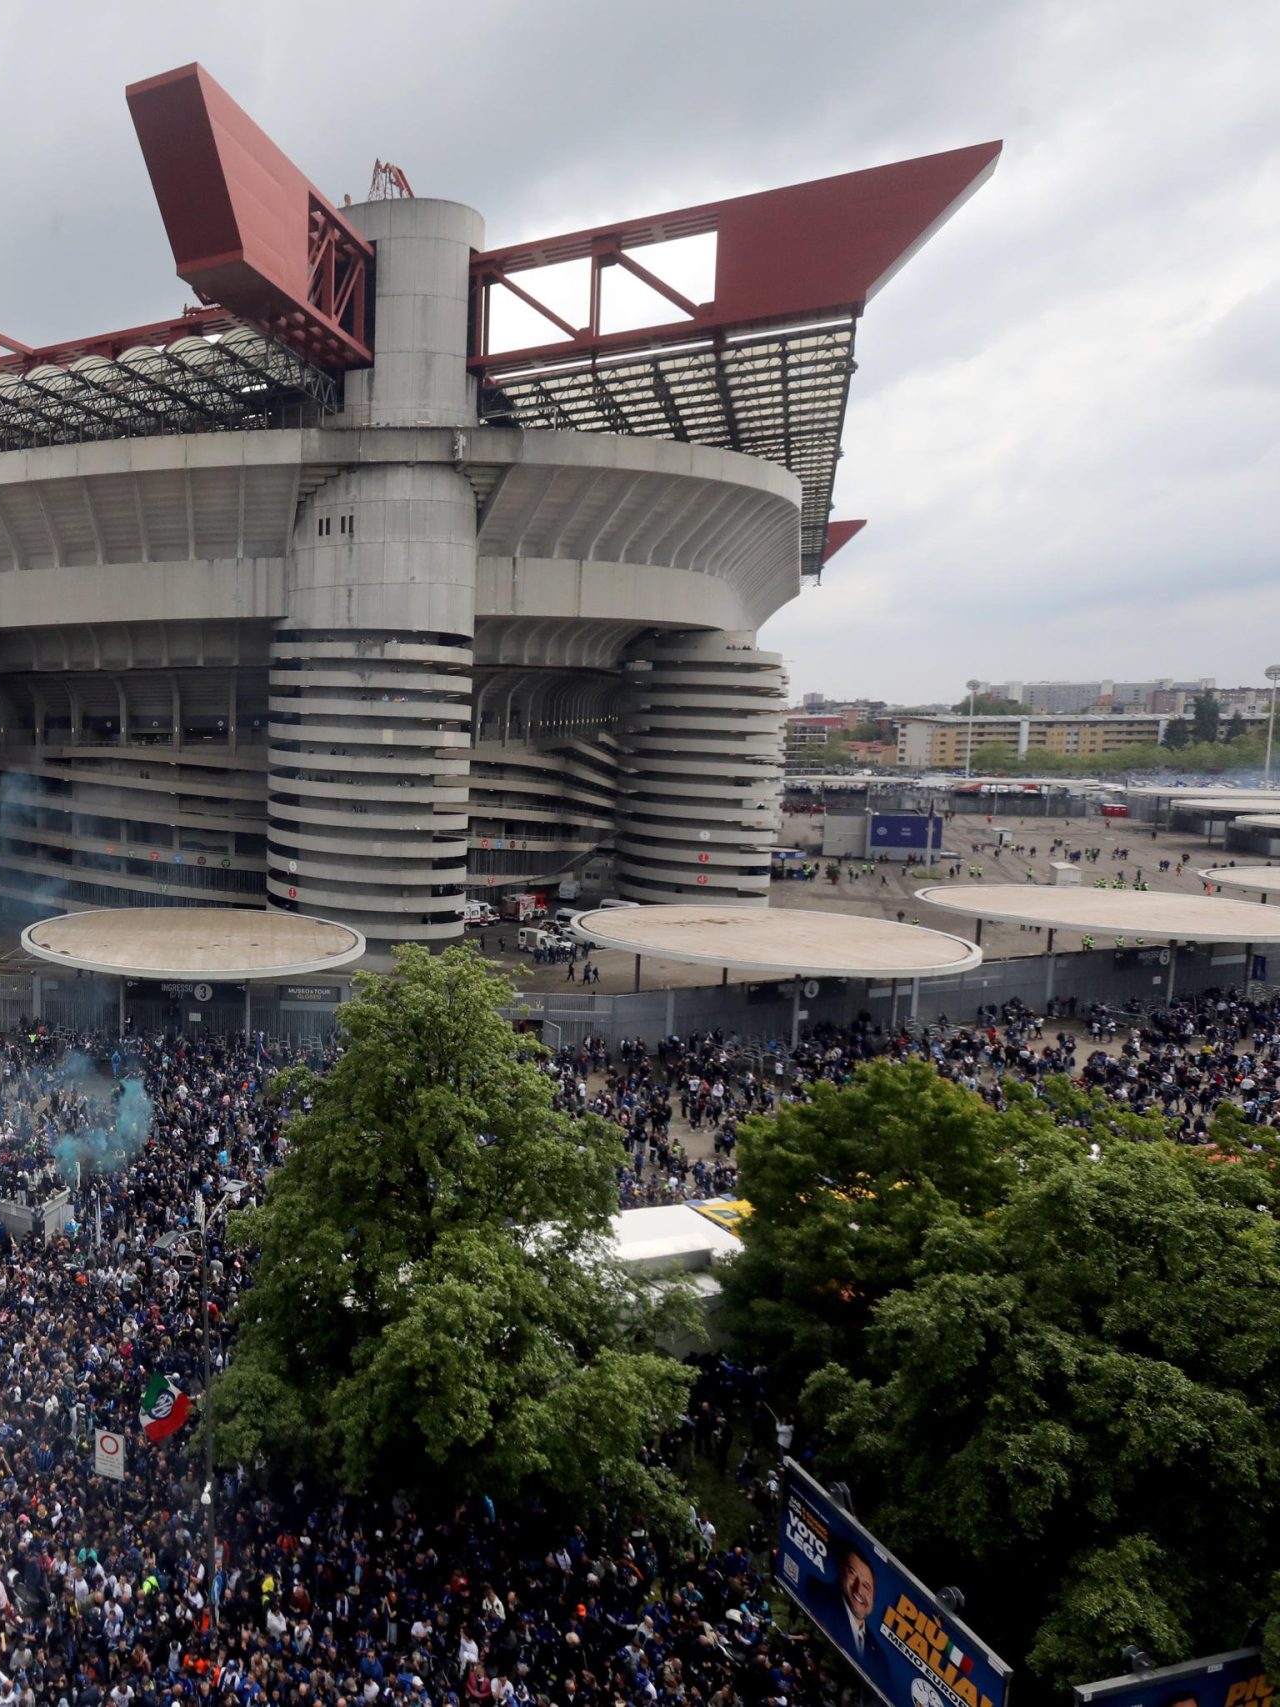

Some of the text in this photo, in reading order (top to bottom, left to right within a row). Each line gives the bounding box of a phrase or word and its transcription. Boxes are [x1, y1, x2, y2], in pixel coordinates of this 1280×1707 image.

[161, 983, 193, 993] INGRESSO
[785, 1522, 825, 1575] LEGA
[788, 1509, 827, 1557] VOTO
[896, 1593, 949, 1651] PIÙ
[888, 1631, 923, 1669] MENO
